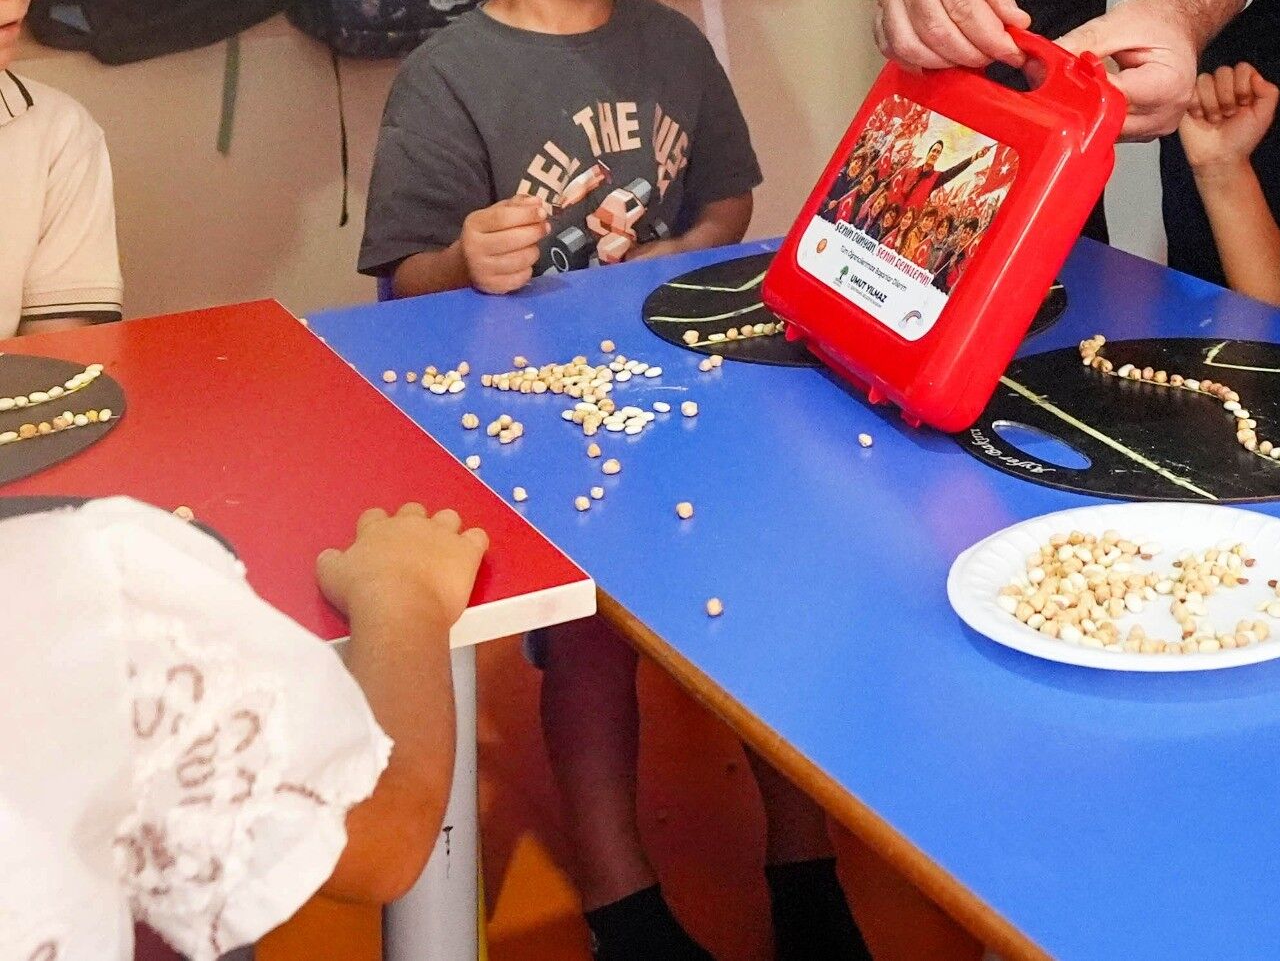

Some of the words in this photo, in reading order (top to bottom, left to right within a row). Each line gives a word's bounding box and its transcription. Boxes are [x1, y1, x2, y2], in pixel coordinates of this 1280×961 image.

[572, 101, 642, 158] THE
[850, 274, 867, 289] UMUT
[865, 284, 887, 304] YILMAZ
